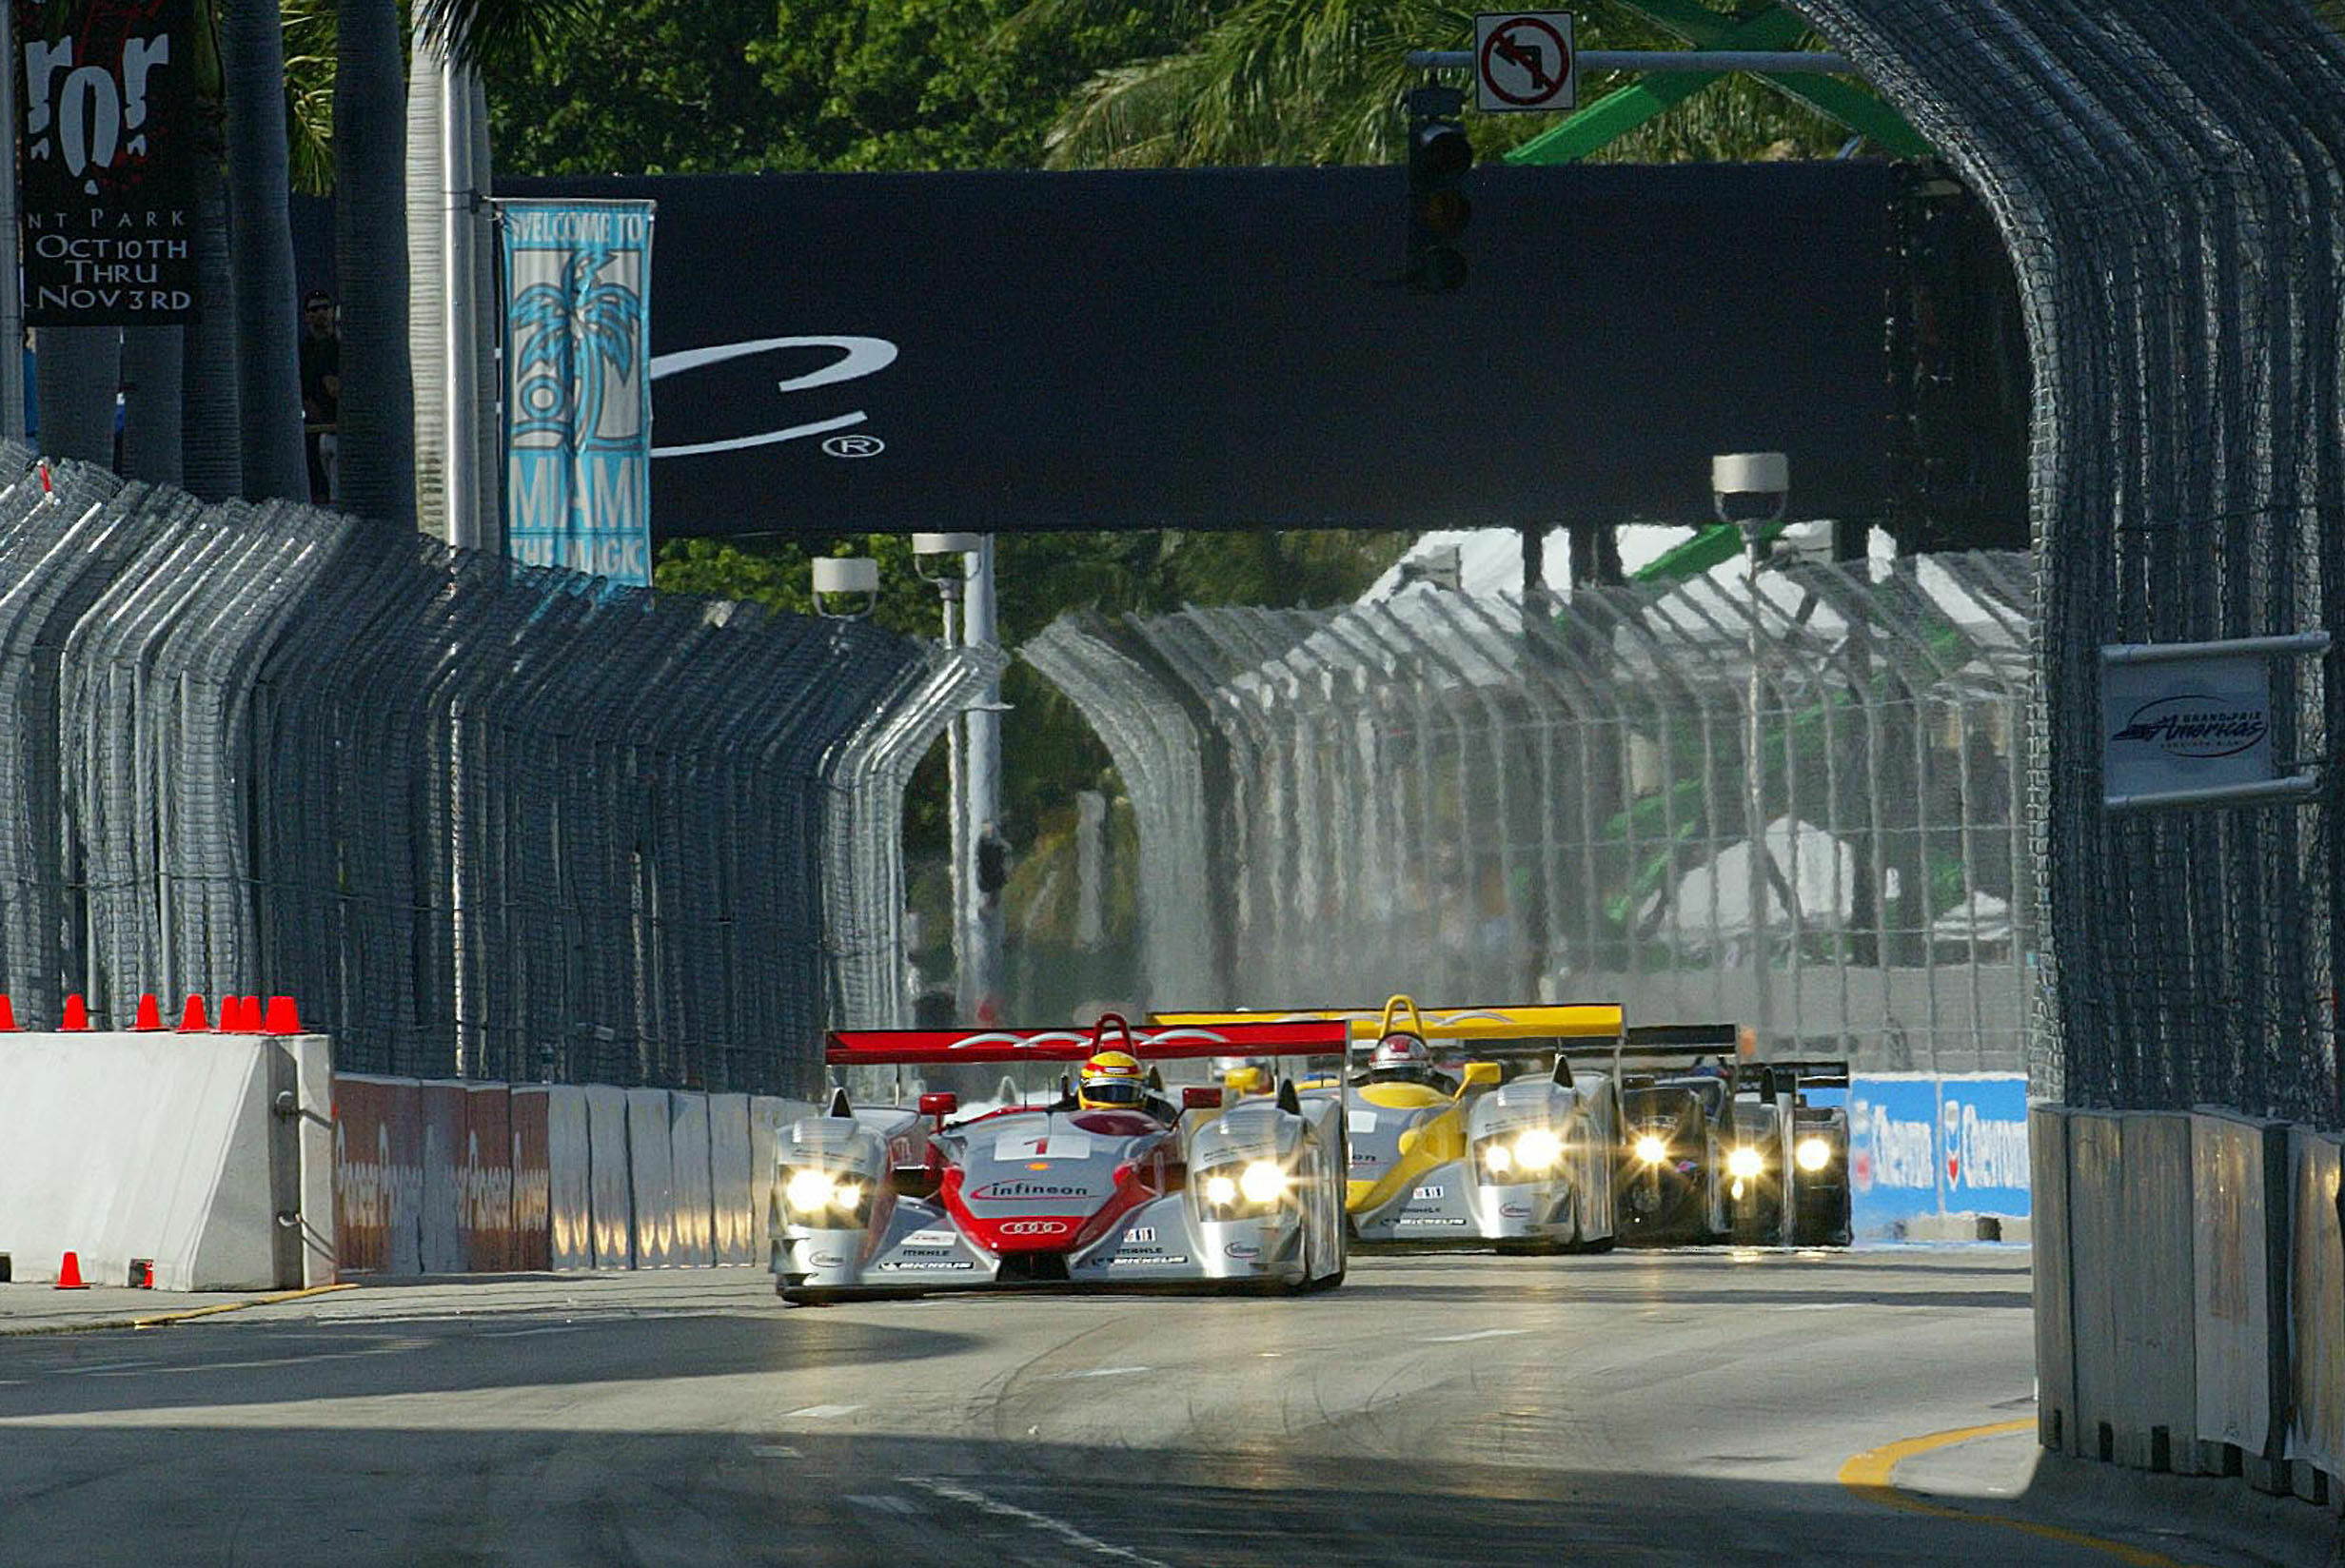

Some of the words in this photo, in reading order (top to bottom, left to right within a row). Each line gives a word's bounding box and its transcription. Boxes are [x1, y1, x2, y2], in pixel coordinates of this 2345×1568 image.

[90, 208, 185, 228] PARK
[511, 211, 610, 243] WELCOME
[618, 212, 643, 242] TO
[64, 260, 158, 284] THRU
[39, 285, 121, 310] NOV
[509, 456, 643, 528] MIAMI
[510, 537, 553, 571] THE
[563, 538, 644, 576] MAGIC
[992, 1183, 1088, 1197] infineon
